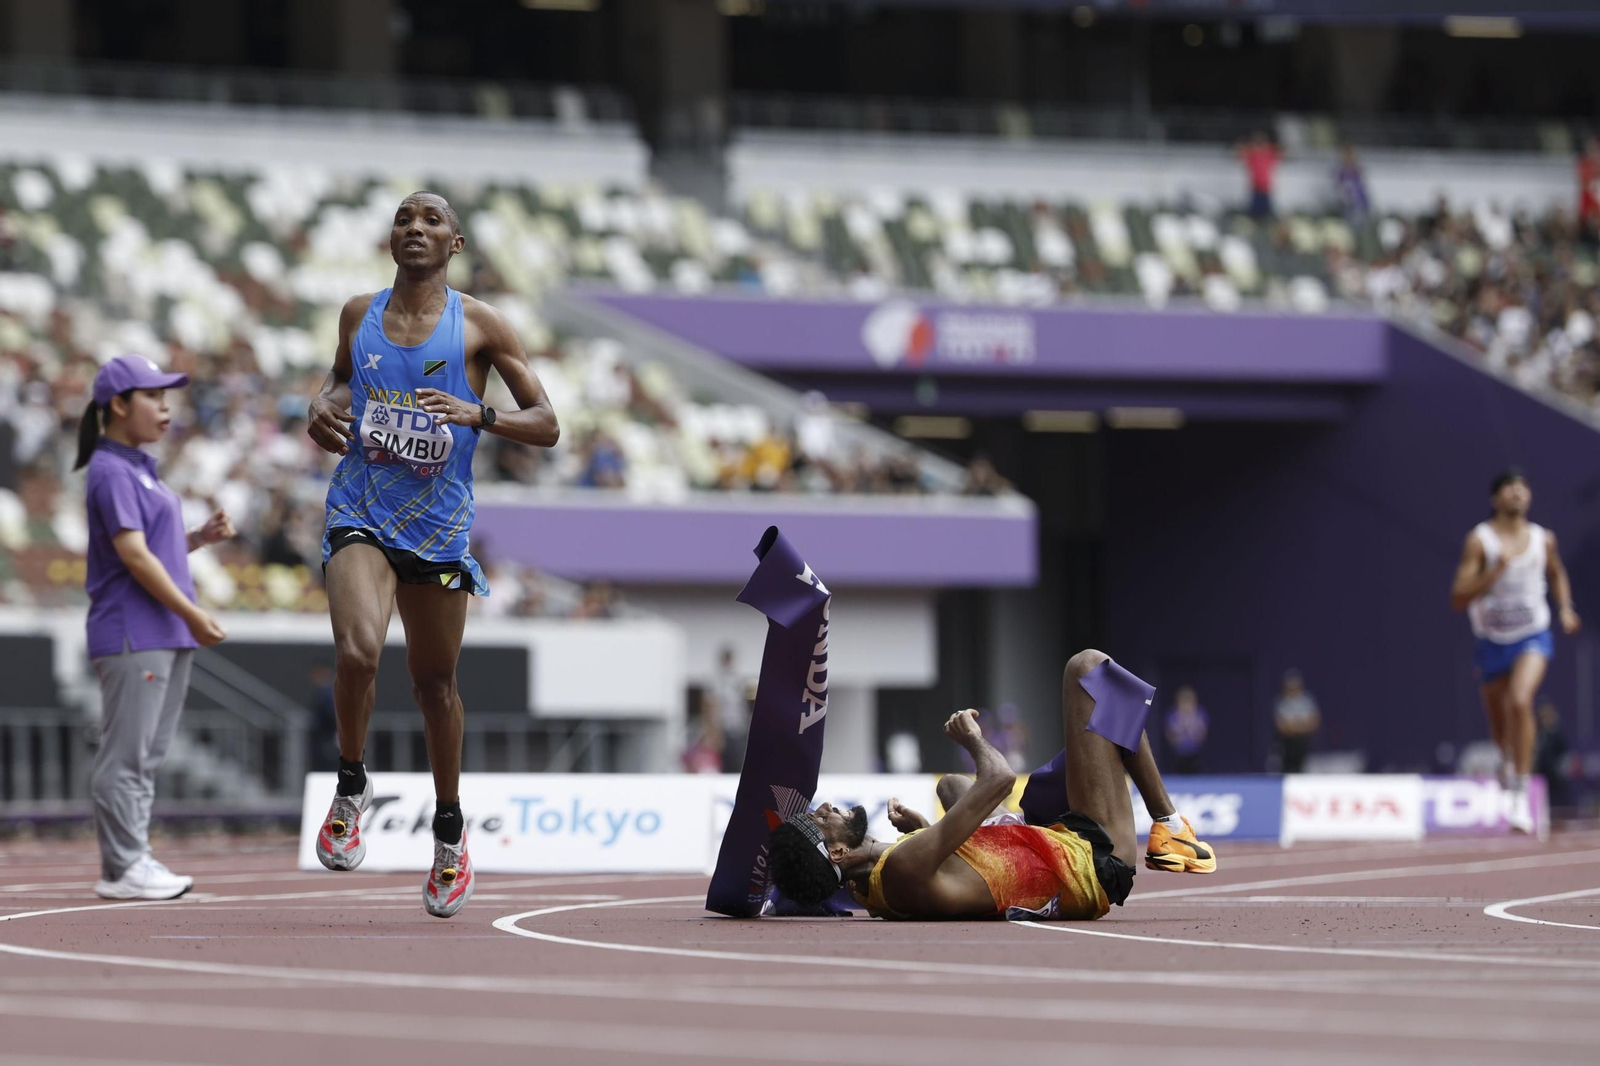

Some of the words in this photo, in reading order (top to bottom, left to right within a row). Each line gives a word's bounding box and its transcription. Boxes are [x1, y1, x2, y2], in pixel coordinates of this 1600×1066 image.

[364, 385, 419, 409] ANZA
[369, 430, 447, 461] SIMBU
[511, 797, 662, 847] Tokyo
